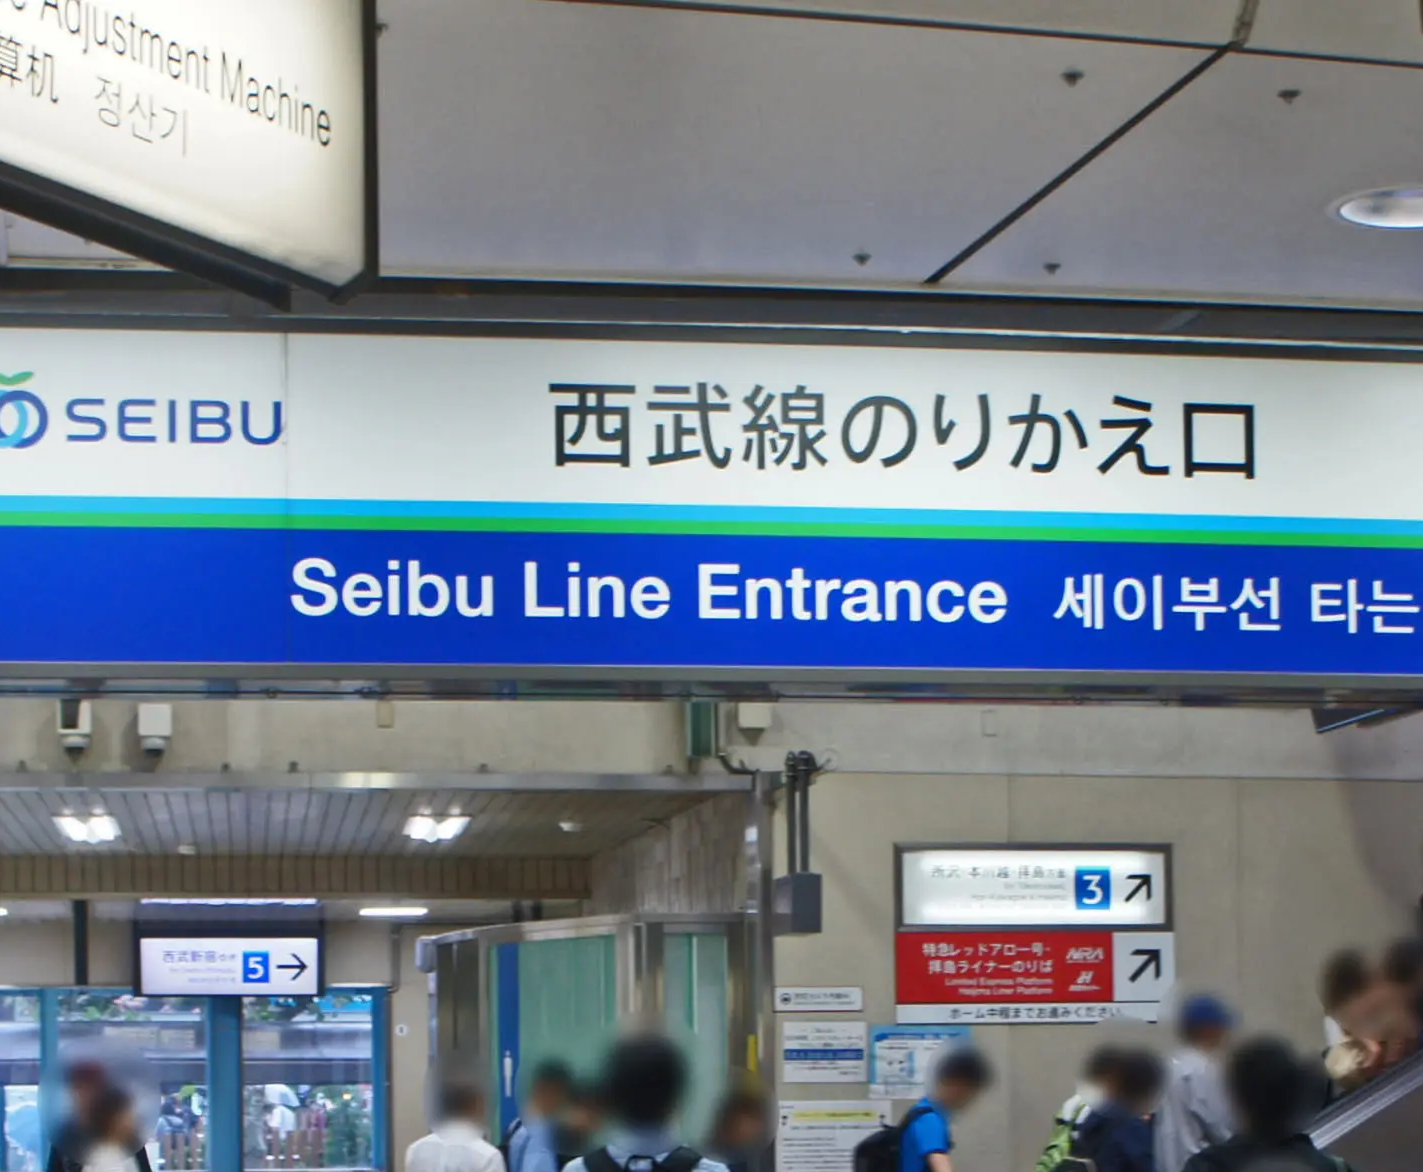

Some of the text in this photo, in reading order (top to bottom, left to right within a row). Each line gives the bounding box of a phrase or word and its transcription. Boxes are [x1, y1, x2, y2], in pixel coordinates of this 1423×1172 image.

[94, 75, 190, 158] 정산기
[220, 51, 333, 147] Machine
[65, 397, 284, 447] SEIBU
[548, 382, 1257, 480] 西武線のりかえ口
[290, 556, 1009, 624] Seibu Line Entrance
[1053, 572, 1284, 632] 세이부선
[1310, 578, 1422, 635] 타는
[1081, 874, 1104, 906] 3
[247, 956, 265, 980] 5
